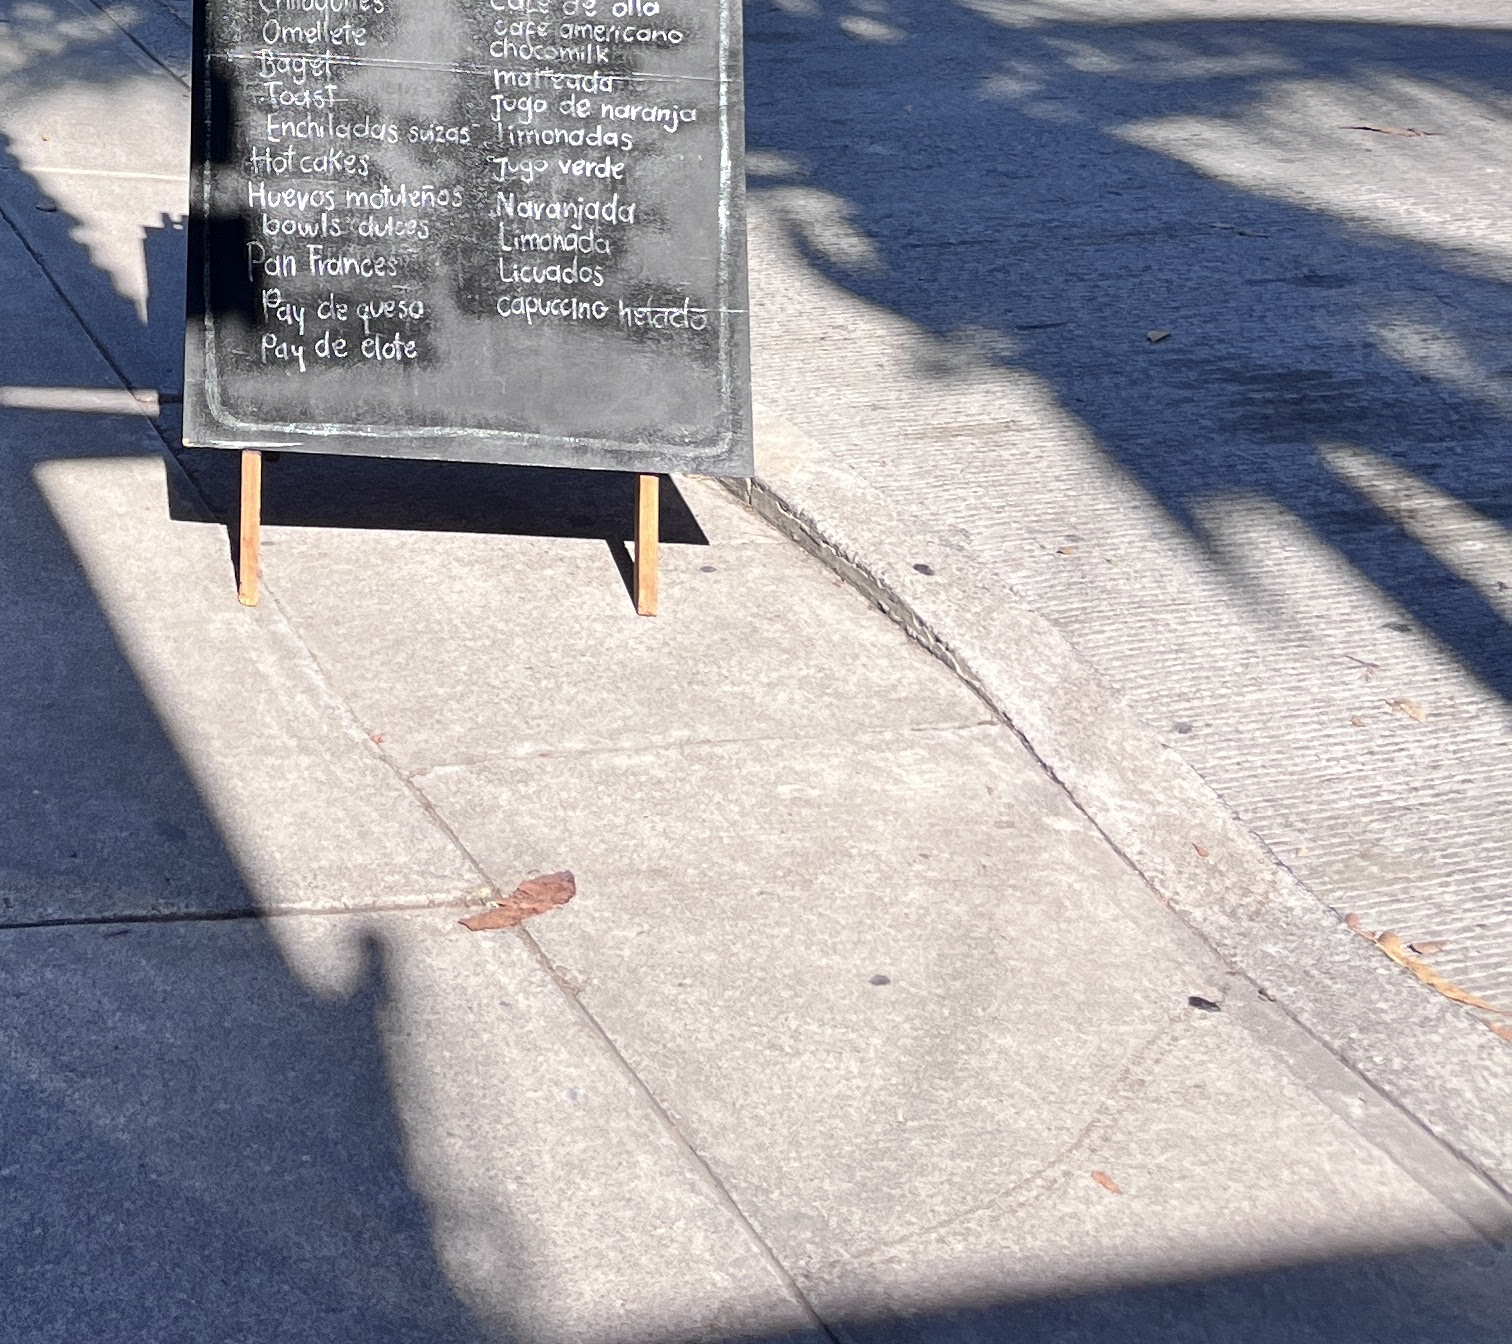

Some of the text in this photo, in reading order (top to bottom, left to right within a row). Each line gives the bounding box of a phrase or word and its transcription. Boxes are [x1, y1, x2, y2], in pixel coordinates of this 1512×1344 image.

[560, 22, 684, 44] americano
[489, 38, 609, 64] chocomilk
[263, 81, 338, 109] Toast
[267, 112, 472, 145] Enchiladas suizas
[490, 92, 697, 133] Jugo de naranja
[491, 155, 625, 183] Jugo verde
[248, 180, 463, 211] Huevos motuleños
[496, 191, 636, 231] Naranjada
[262, 211, 430, 240] bowls dulces
[499, 221, 612, 255] Limonada
[246, 240, 399, 283] Pan Frances
[498, 256, 604, 287] Licuados
[261, 287, 306, 335] Pay
[316, 293, 349, 322] de
[496, 296, 708, 330] capuccino helado
[261, 330, 418, 373] Pay de elote
